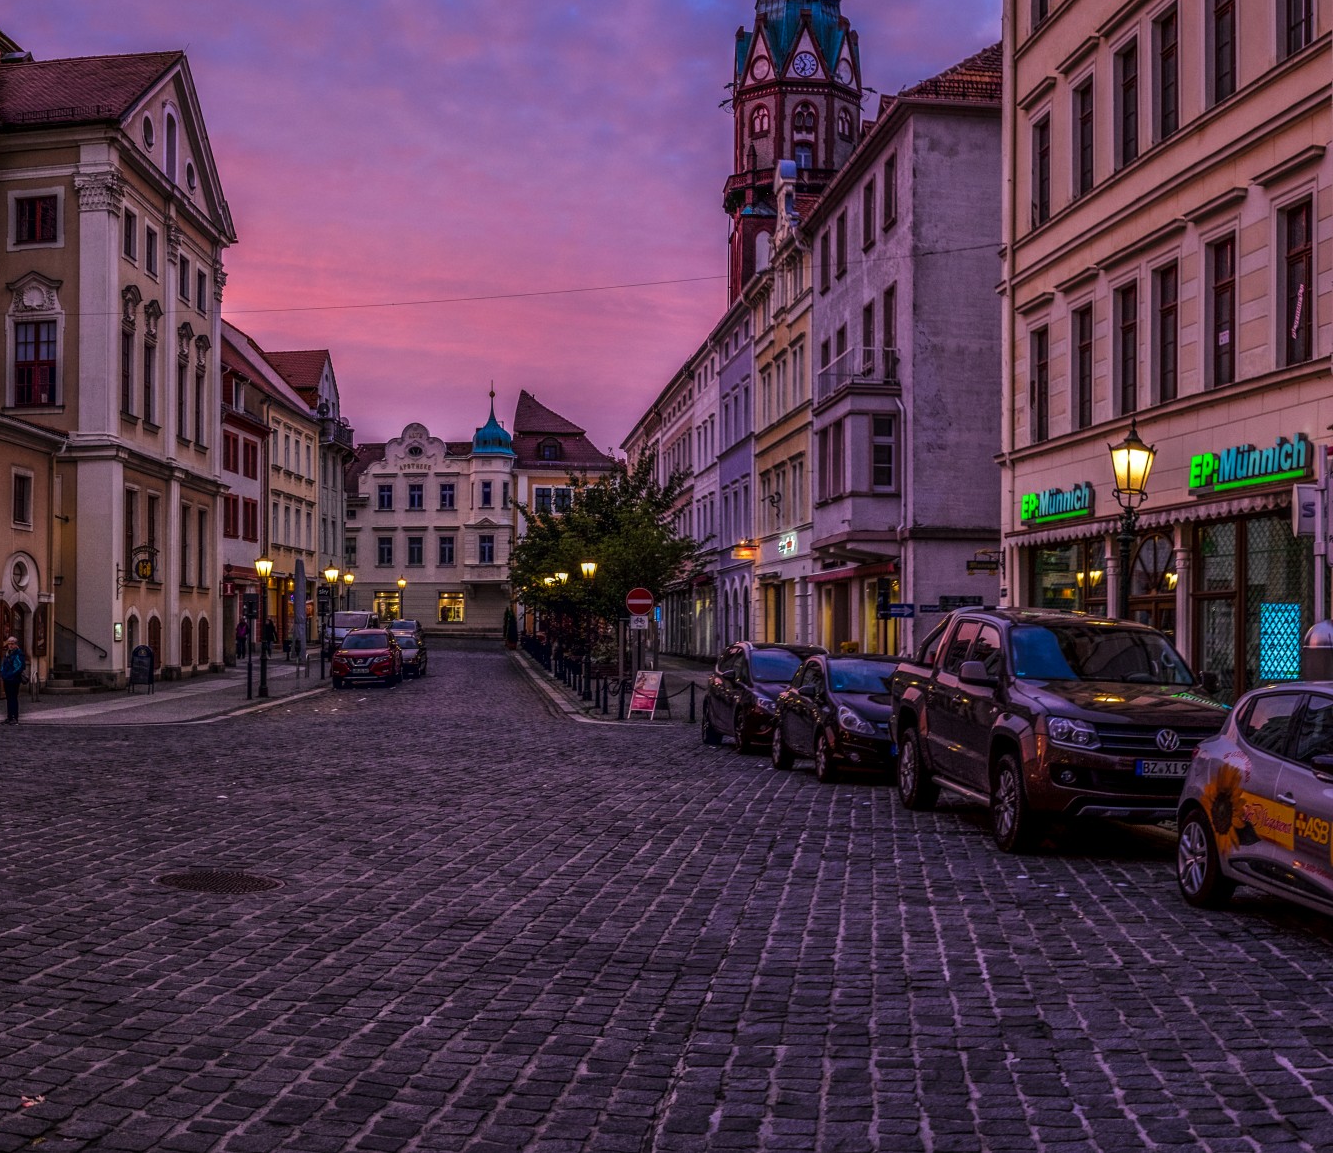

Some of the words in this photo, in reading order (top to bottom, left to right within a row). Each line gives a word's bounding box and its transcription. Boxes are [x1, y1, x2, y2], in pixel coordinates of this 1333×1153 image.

[1189, 432, 1306, 488] EP:Münnich
[1021, 481, 1090, 520] EP:Münnich
[318, 588, 329, 596] sky
[1143, 762, 1157, 774] BZ
[1303, 817, 1330, 845] ASB
